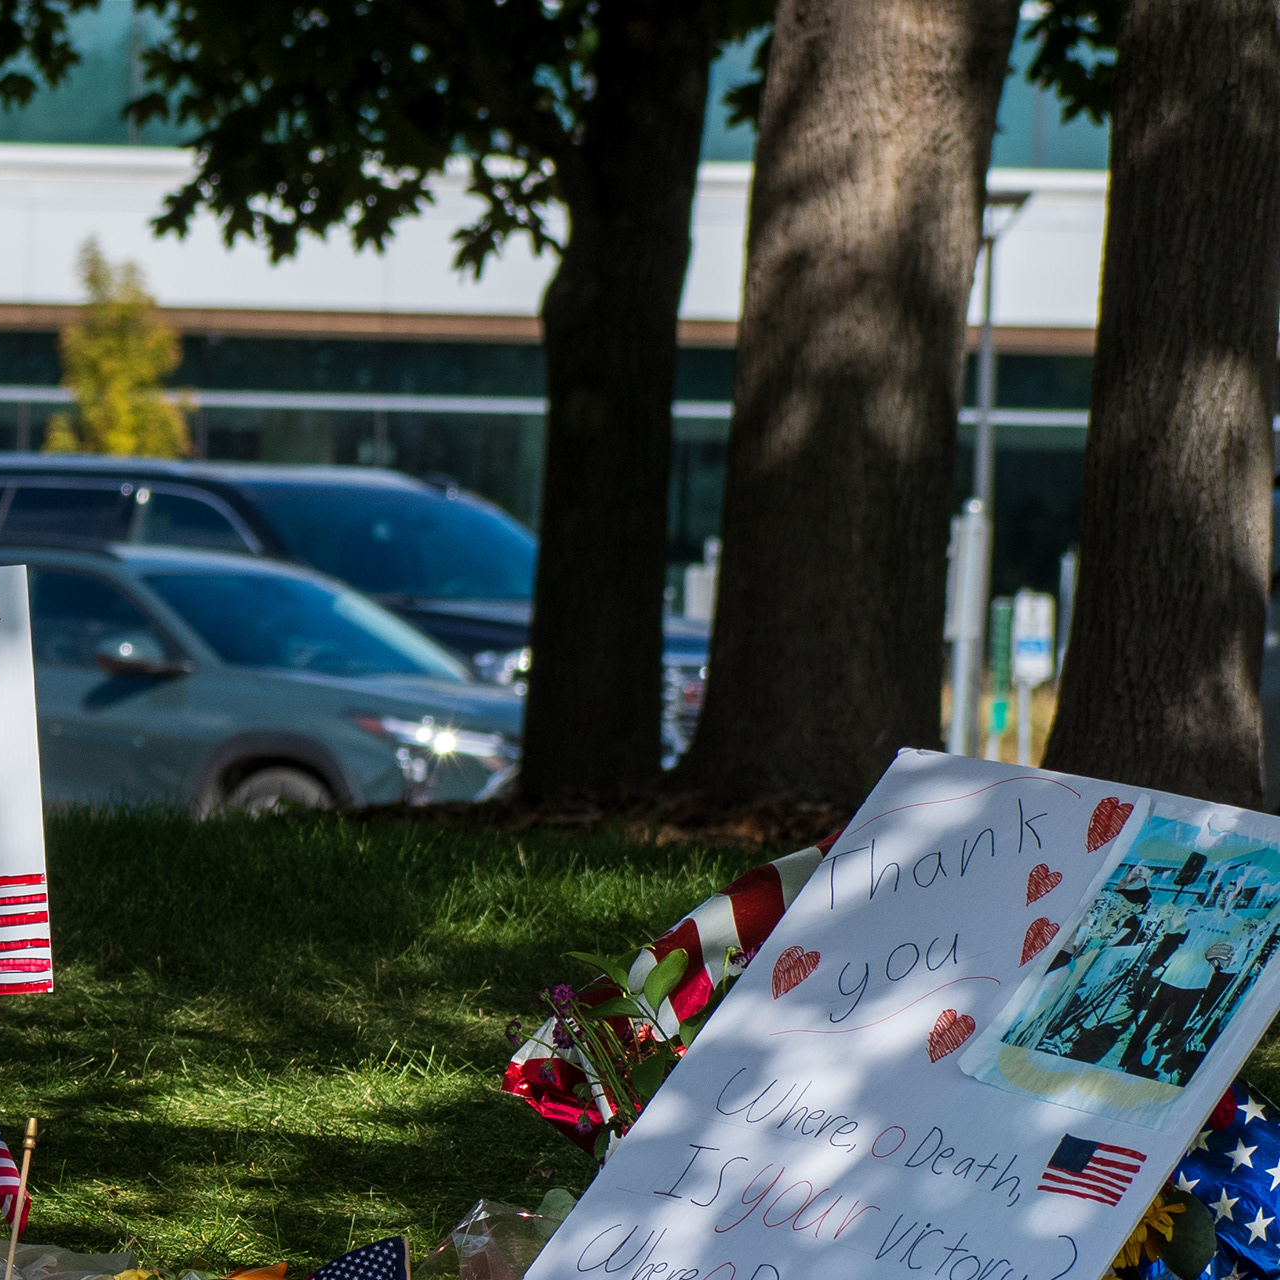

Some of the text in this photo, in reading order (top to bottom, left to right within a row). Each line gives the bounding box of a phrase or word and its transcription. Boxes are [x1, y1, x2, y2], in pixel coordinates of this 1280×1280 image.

[825, 799, 1049, 911] Thank
[828, 931, 961, 1023] you
[716, 1067, 859, 1153] Where,
[905, 1126, 1022, 1208] Death,
[714, 1163, 881, 1241] your
